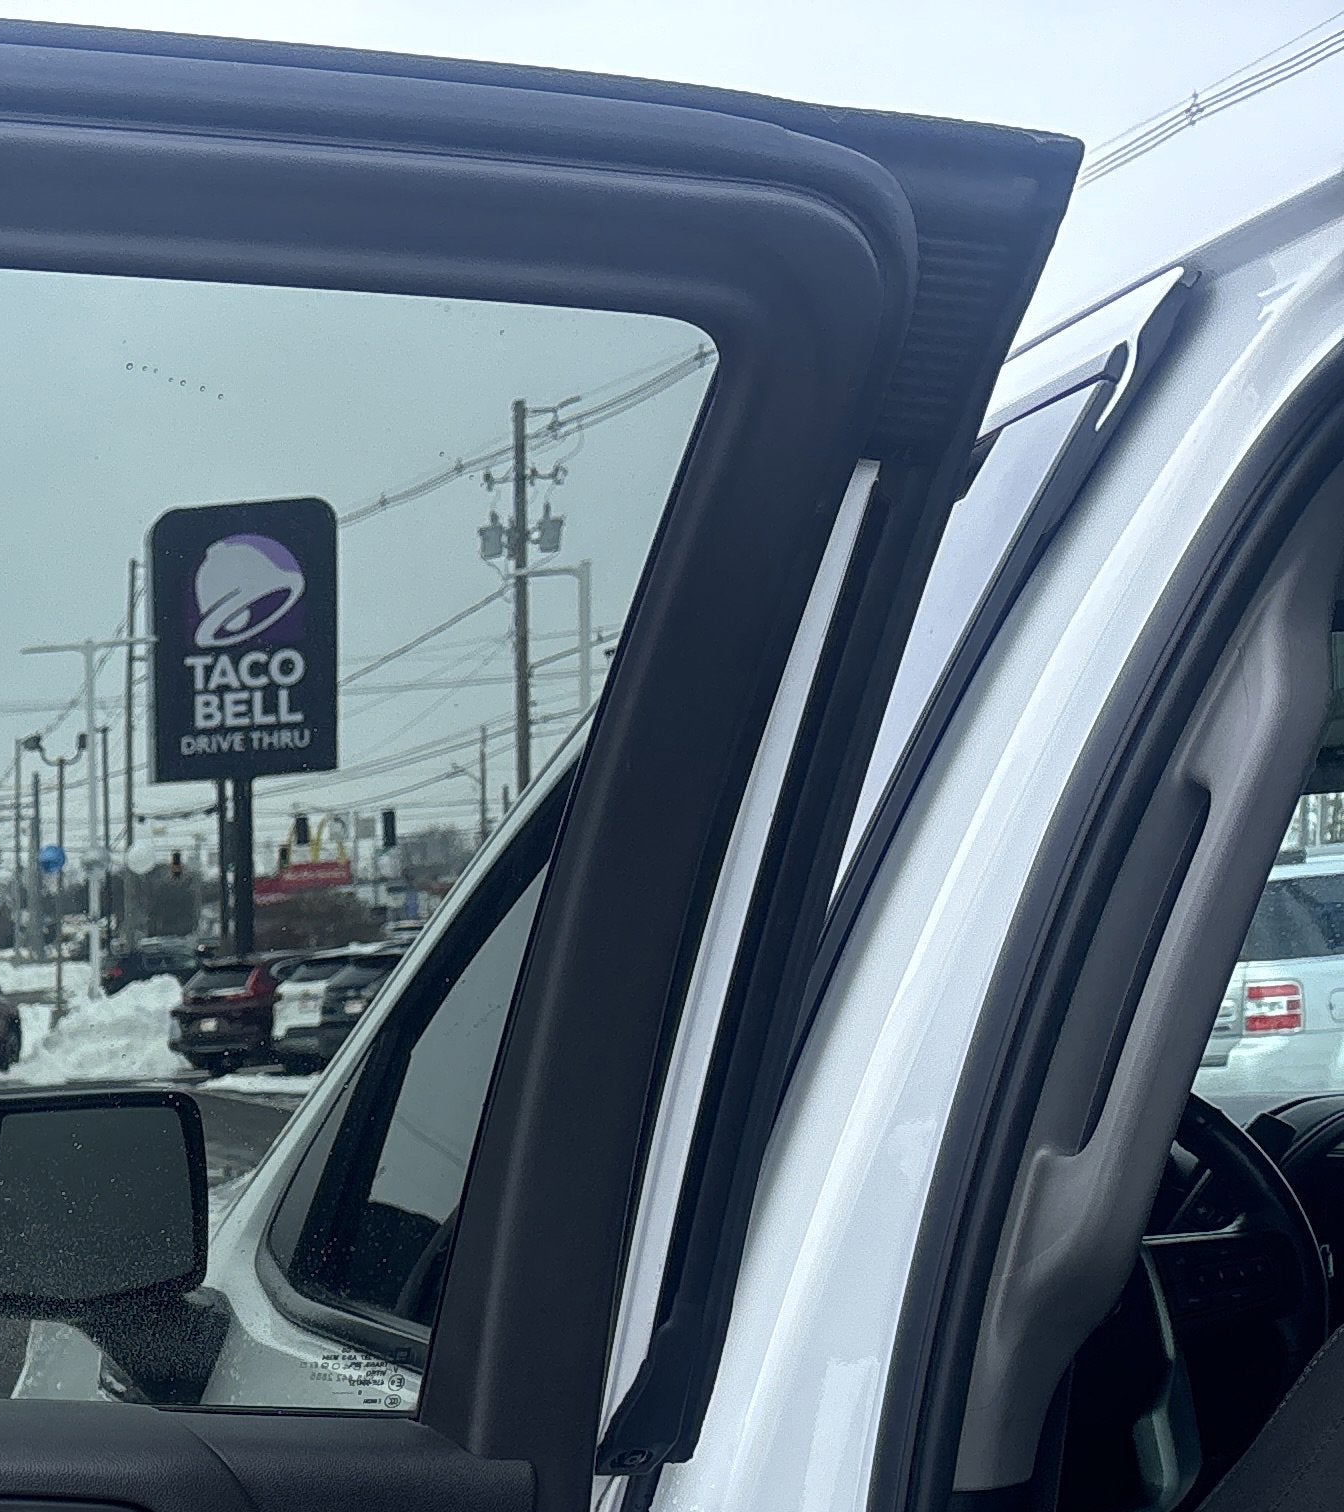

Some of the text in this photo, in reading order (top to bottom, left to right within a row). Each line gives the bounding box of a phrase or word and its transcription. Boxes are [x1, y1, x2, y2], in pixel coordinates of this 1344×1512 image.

[183, 647, 306, 691] TACO
[193, 686, 305, 730] BELL
[180, 728, 312, 756] DRIVE THRU
